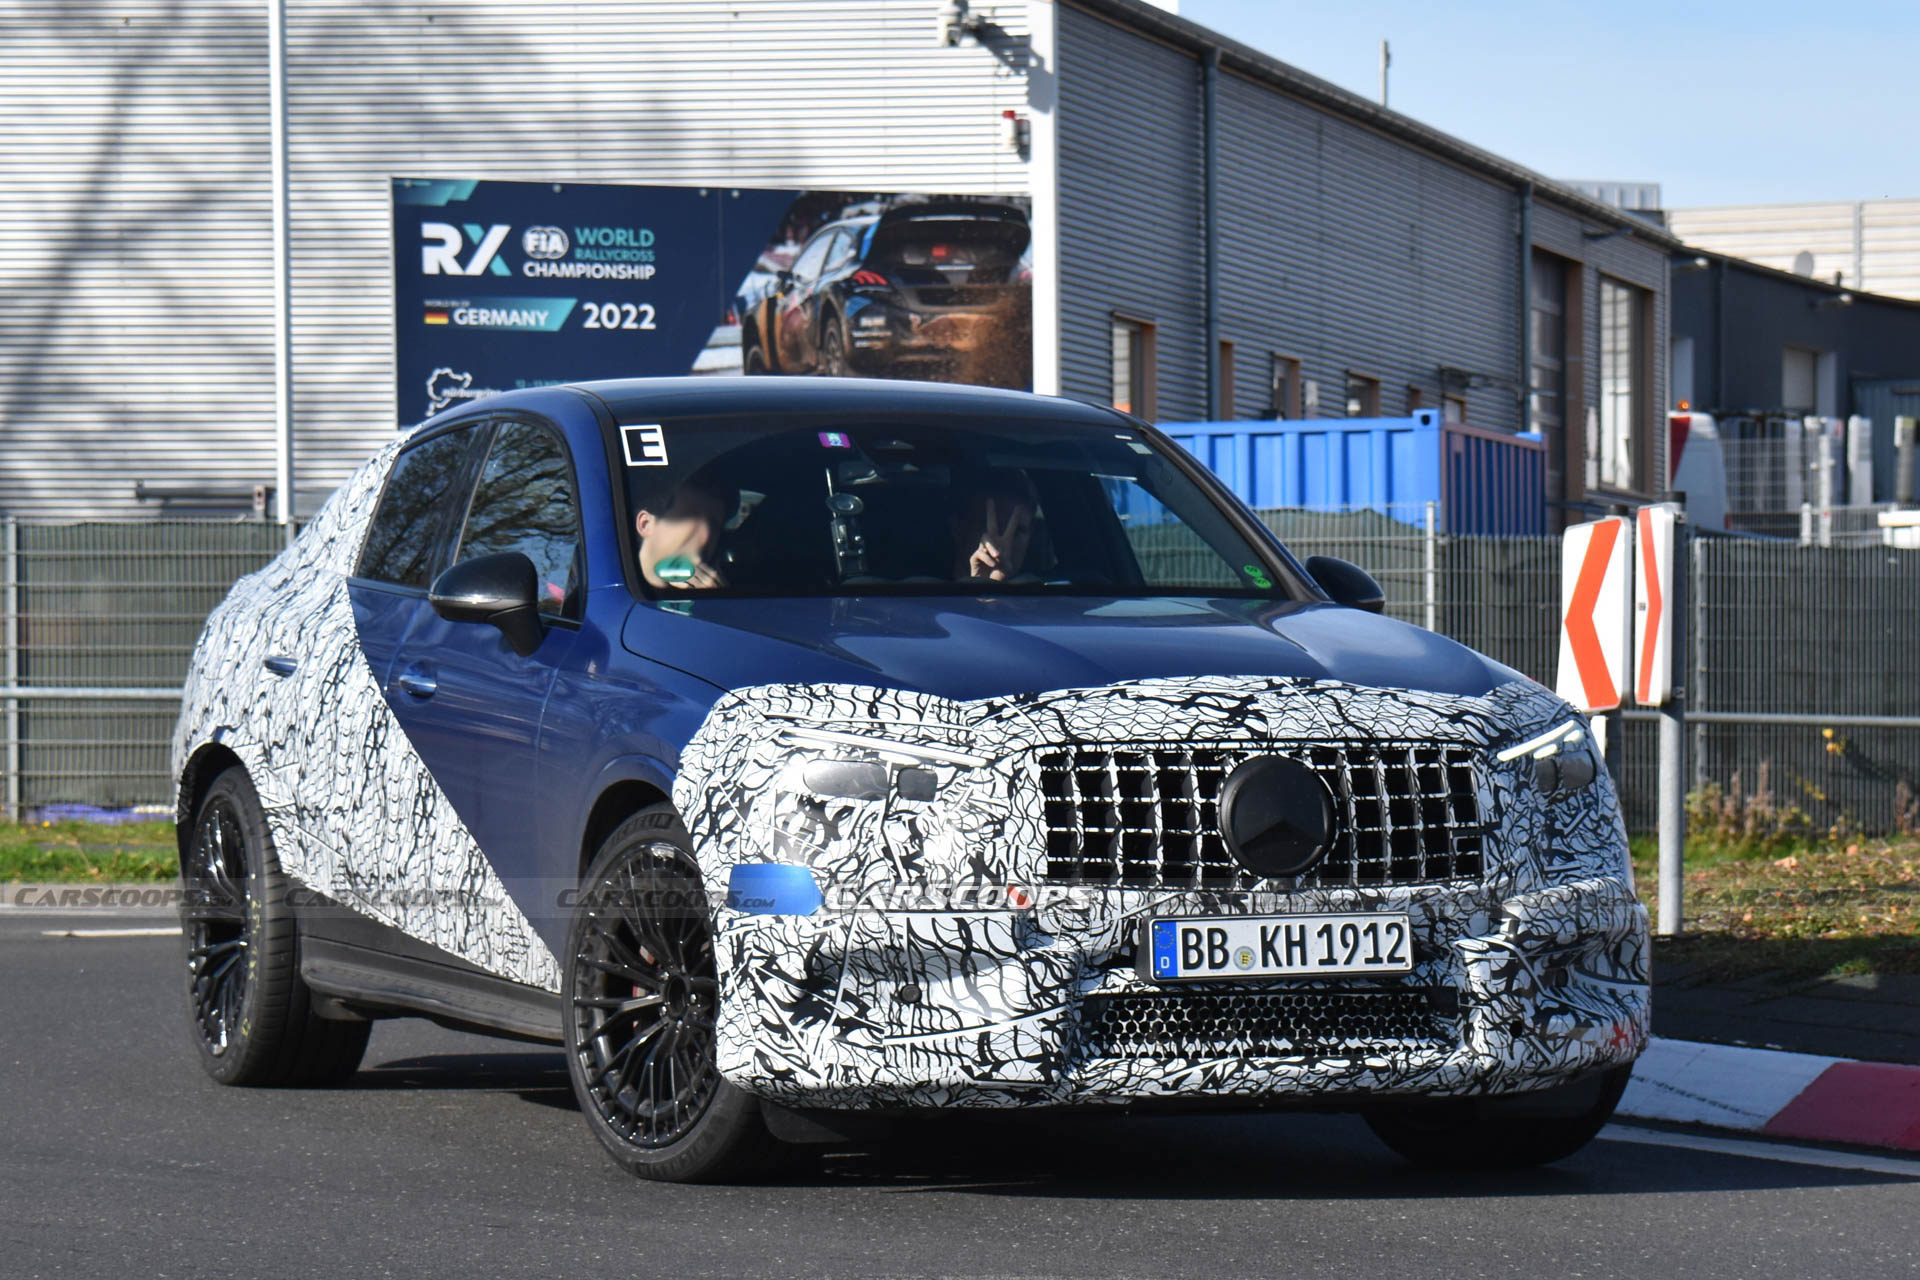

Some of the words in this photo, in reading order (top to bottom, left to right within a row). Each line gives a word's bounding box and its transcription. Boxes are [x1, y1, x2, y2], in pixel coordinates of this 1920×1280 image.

[524, 229, 567, 255] FIA
[574, 227, 655, 247] WORLD
[421, 222, 512, 276] RX
[574, 248, 655, 262] RALLYCROSS
[523, 262, 656, 280] CHAMPIONSHIP
[453, 308, 549, 327] GERMANY
[582, 302, 656, 330] 2022
[1181, 926, 1230, 970] BB
[1260, 923, 1307, 967] KH
[1317, 921, 1407, 966] 1912
[1160, 956, 1170, 969] D
